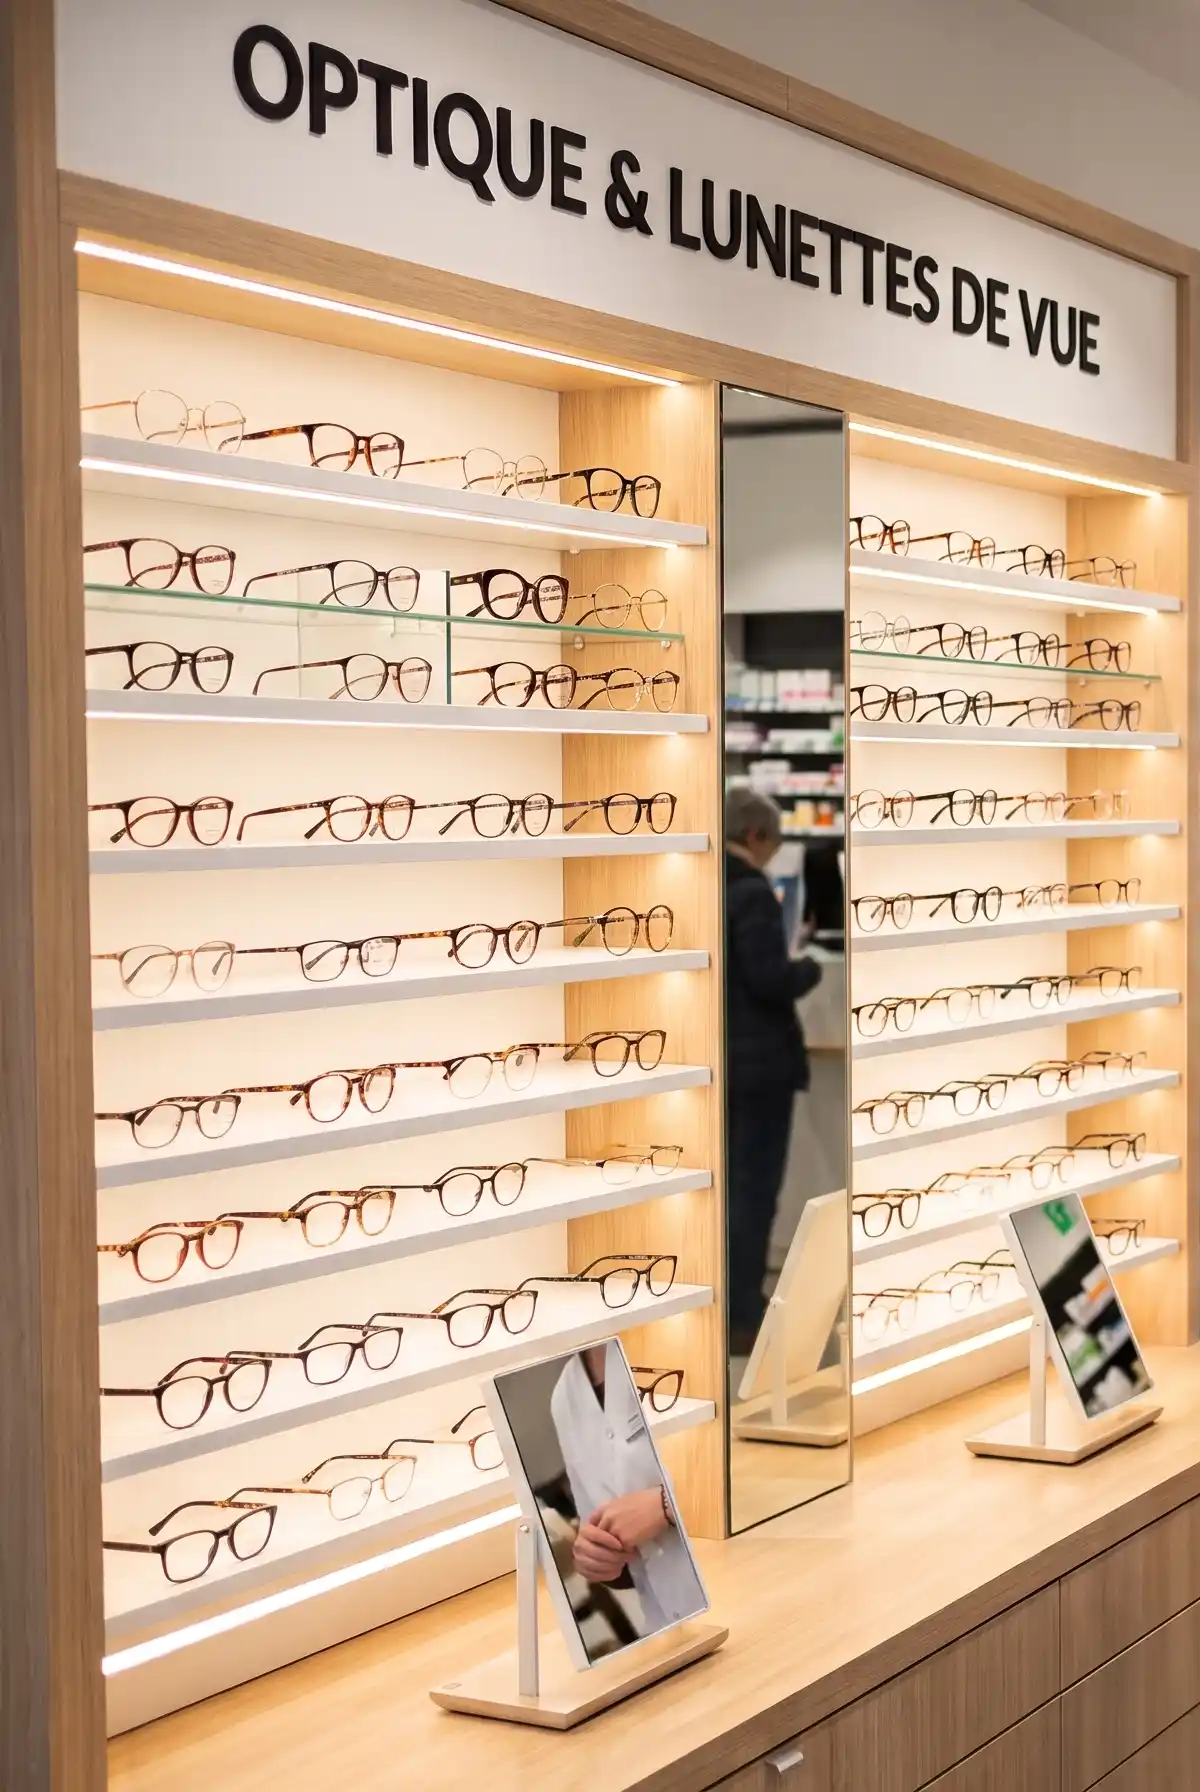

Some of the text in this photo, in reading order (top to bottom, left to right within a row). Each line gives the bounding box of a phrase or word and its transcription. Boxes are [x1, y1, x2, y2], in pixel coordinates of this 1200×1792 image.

[232, 24, 1101, 376] OPTIQUE & LUNETTES DE VUE
